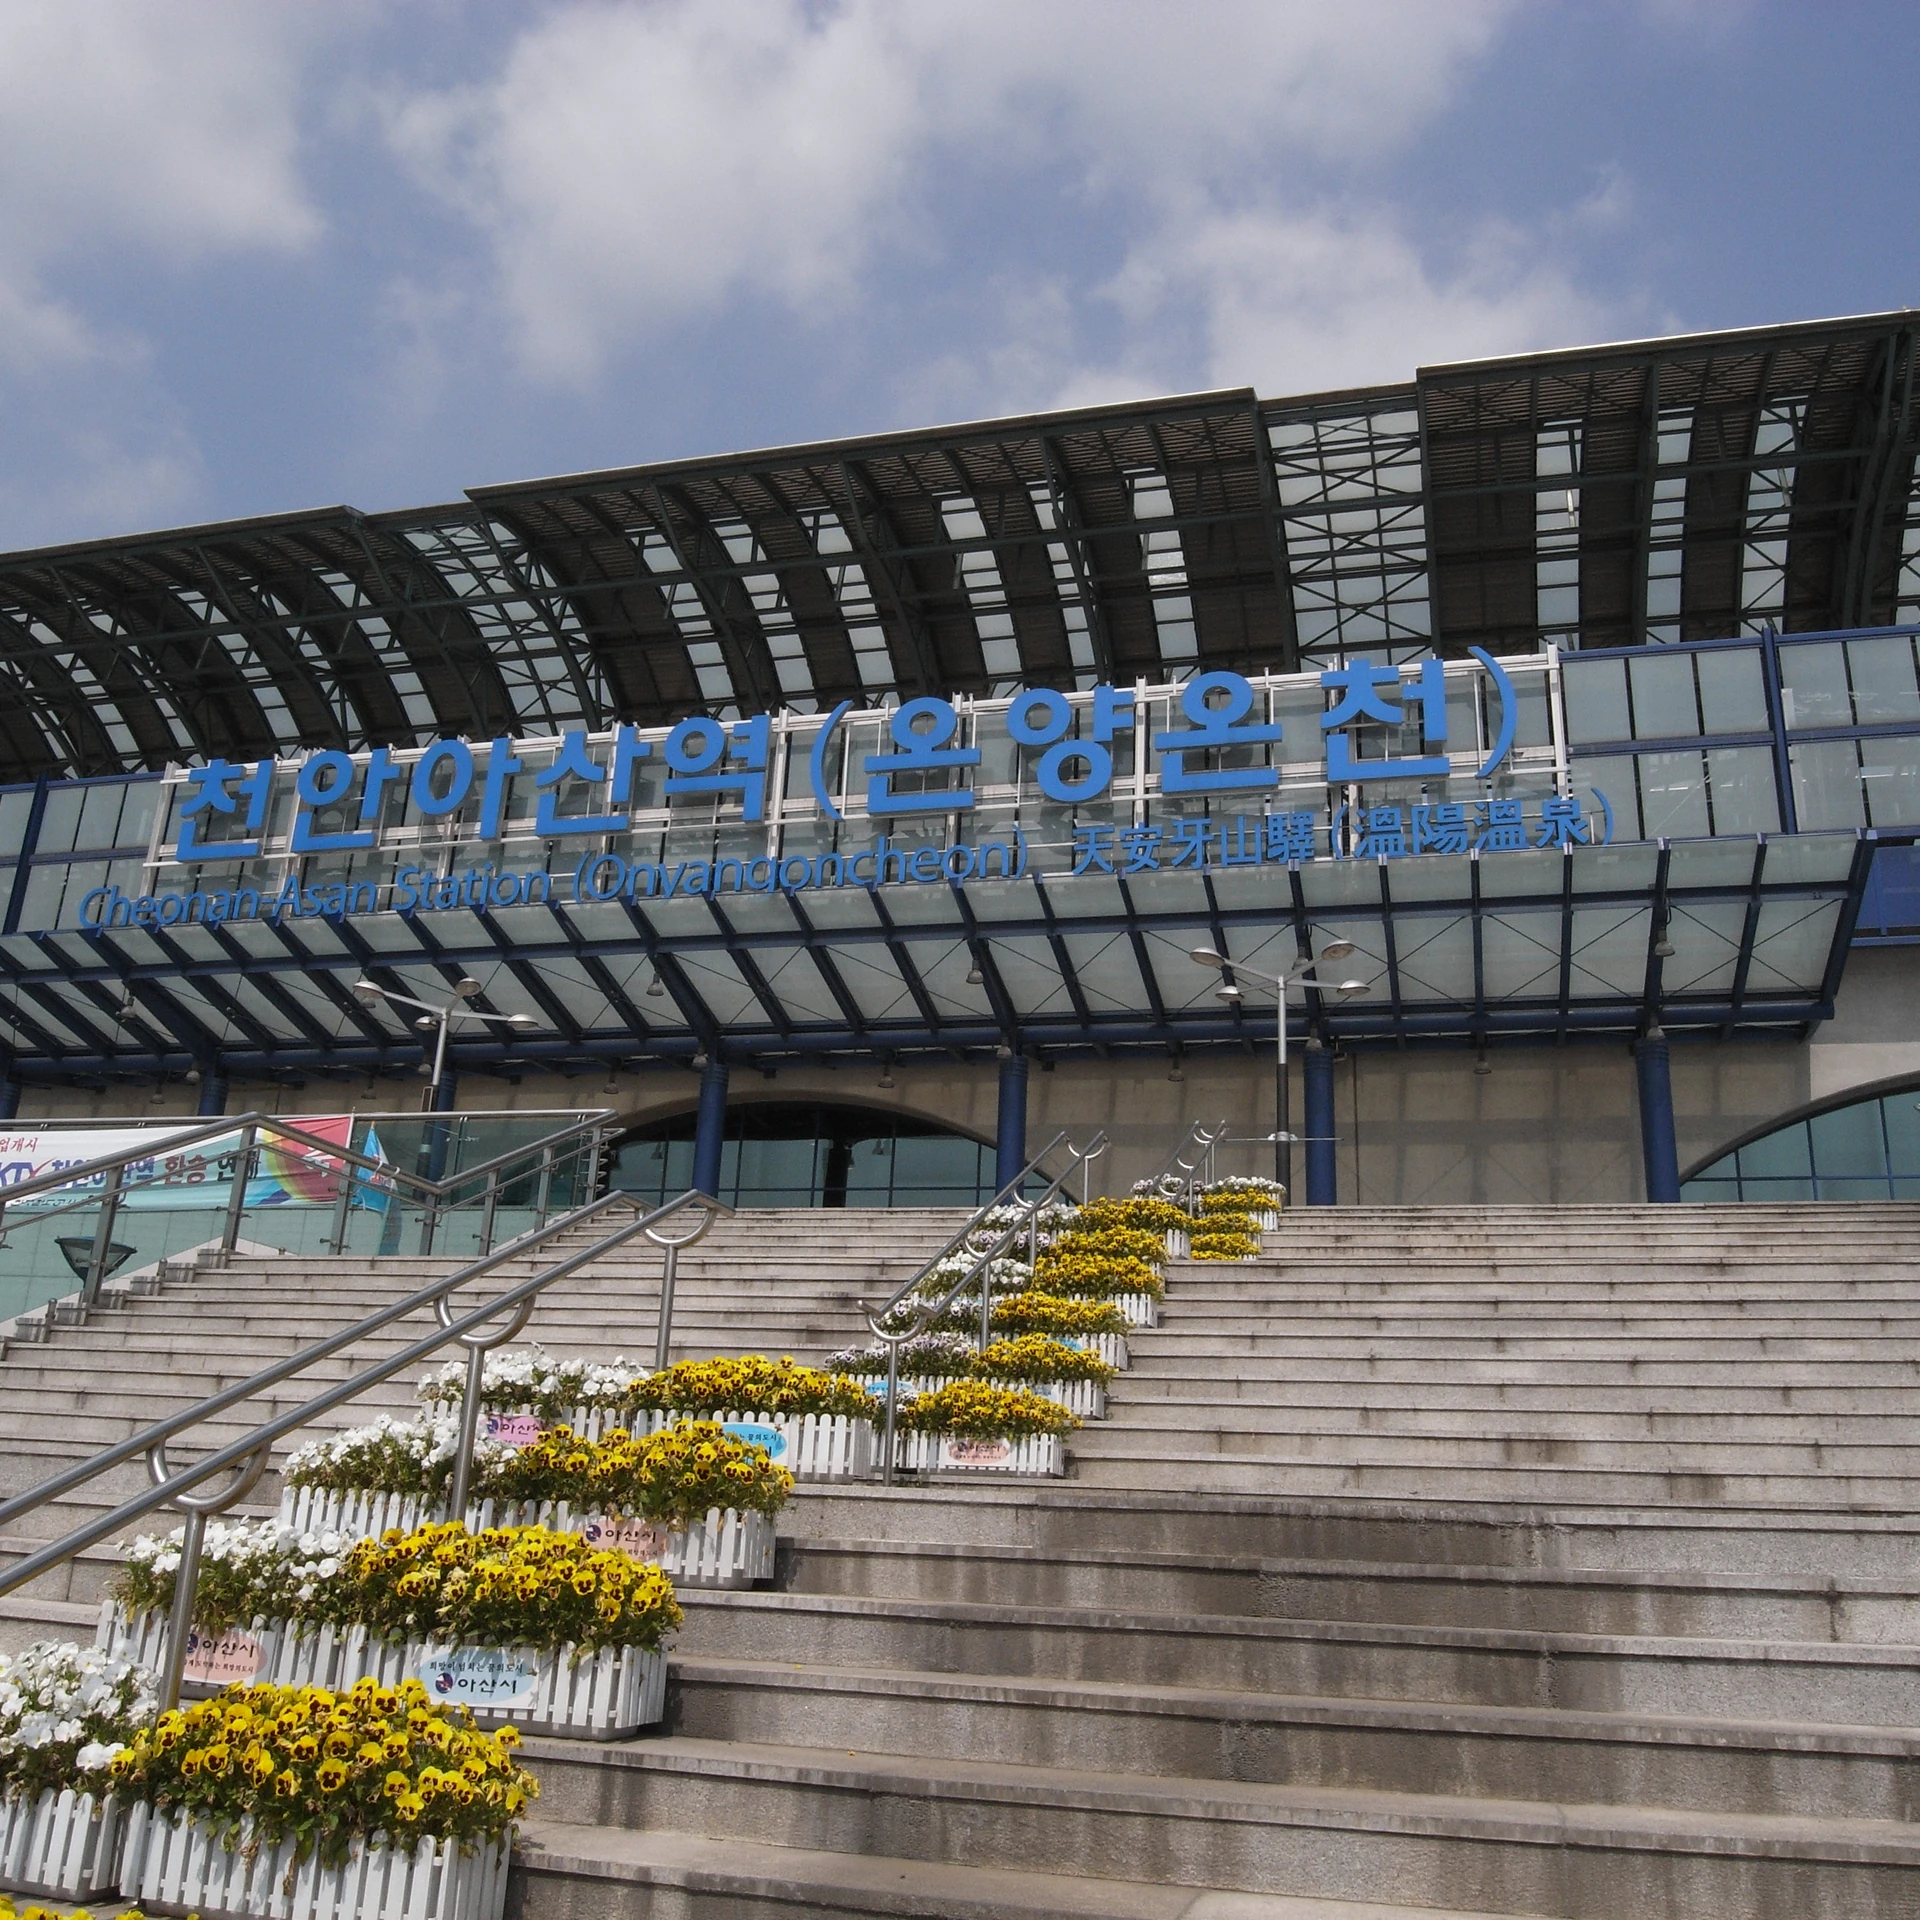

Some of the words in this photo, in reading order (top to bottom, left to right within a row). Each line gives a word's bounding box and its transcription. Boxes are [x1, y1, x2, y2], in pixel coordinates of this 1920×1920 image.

[78, 875, 376, 928] Cheonan-Asan
[391, 861, 551, 910] Station
[605, 1529, 657, 1543] 아산시
[202, 1640, 254, 1658] 아산시
[457, 1678, 517, 1694] 아산시
